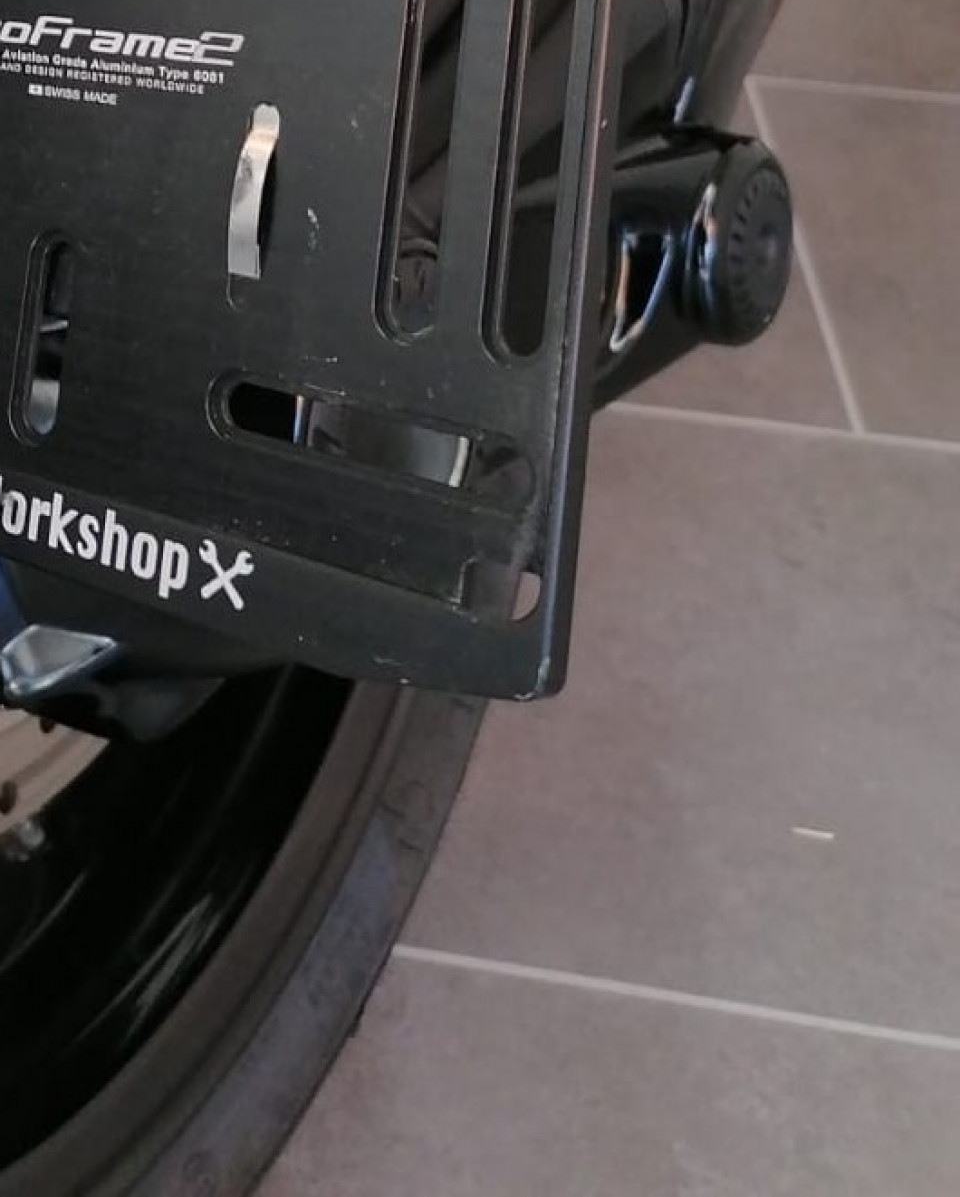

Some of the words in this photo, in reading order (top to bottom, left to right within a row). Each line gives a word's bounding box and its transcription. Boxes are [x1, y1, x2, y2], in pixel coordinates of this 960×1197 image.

[0, 62, 22, 73] AND
[24, 64, 63, 79] DESIGN
[66, 69, 132, 87] REGISTERED
[135, 77, 204, 95] WORLDWIDE
[1, 48, 50, 64] Aviation
[51, 53, 88, 69] Grade
[158, 65, 189, 81] Type
[44, 85, 81, 101] SWISS
[83, 89, 117, 106] MADE
